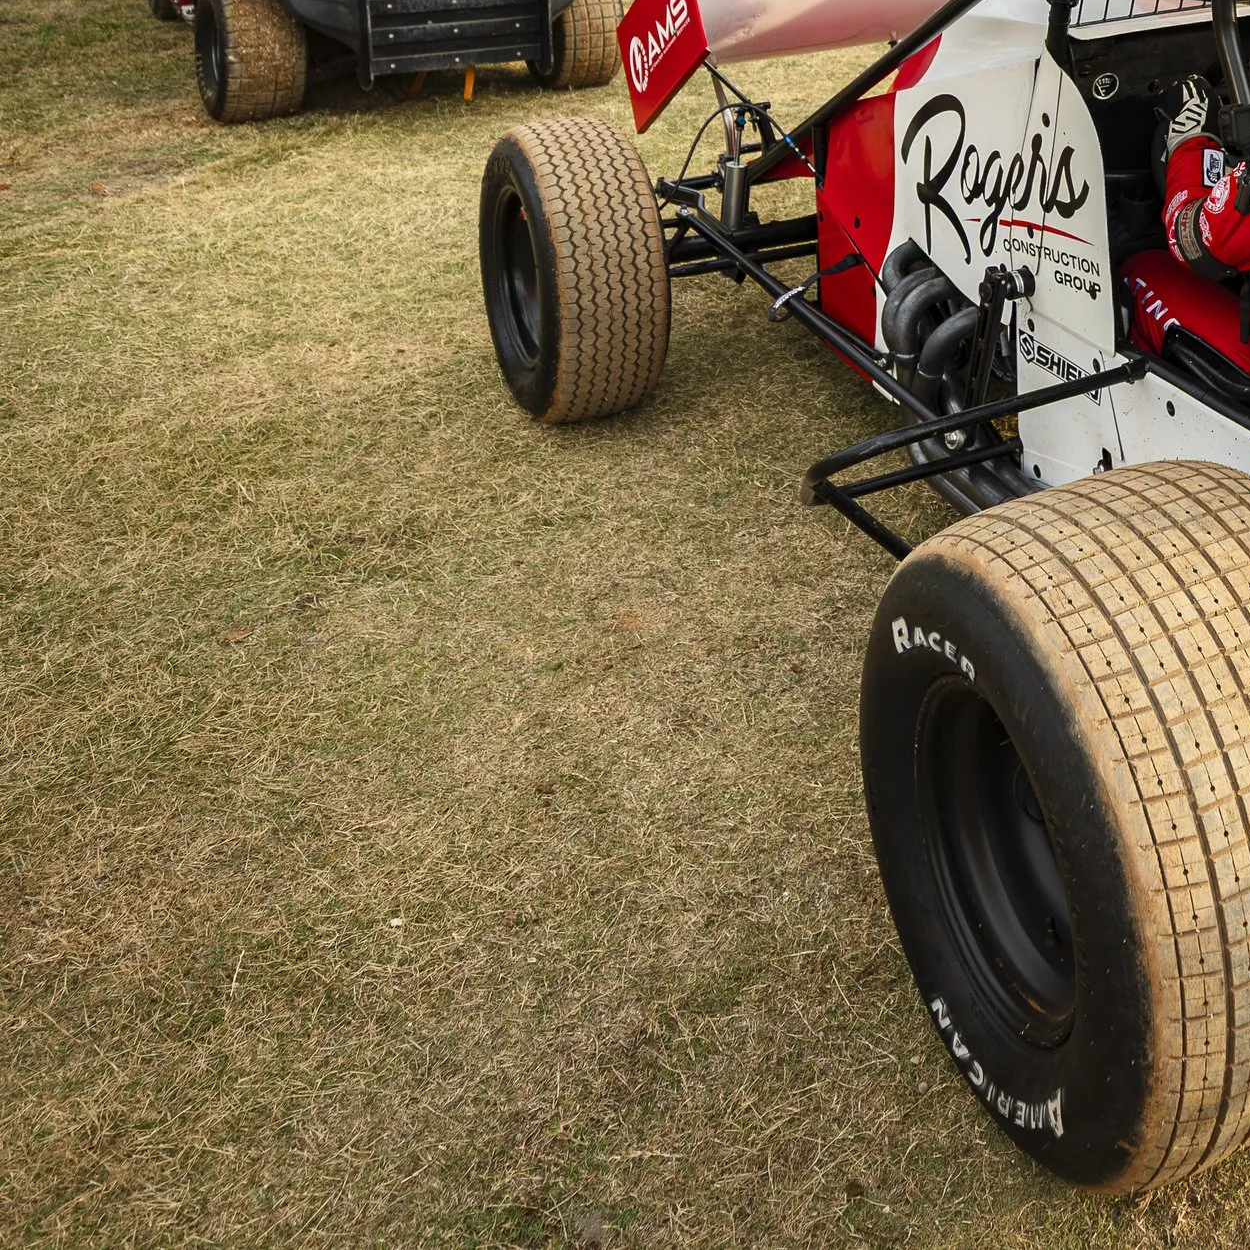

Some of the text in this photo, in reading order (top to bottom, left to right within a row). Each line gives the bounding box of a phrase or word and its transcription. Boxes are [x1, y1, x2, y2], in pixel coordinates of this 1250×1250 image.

[901, 93, 1091, 266] Rogers
[1003, 238, 1101, 278] CONSTRUCTION
[1054, 270, 1101, 294] GROUP
